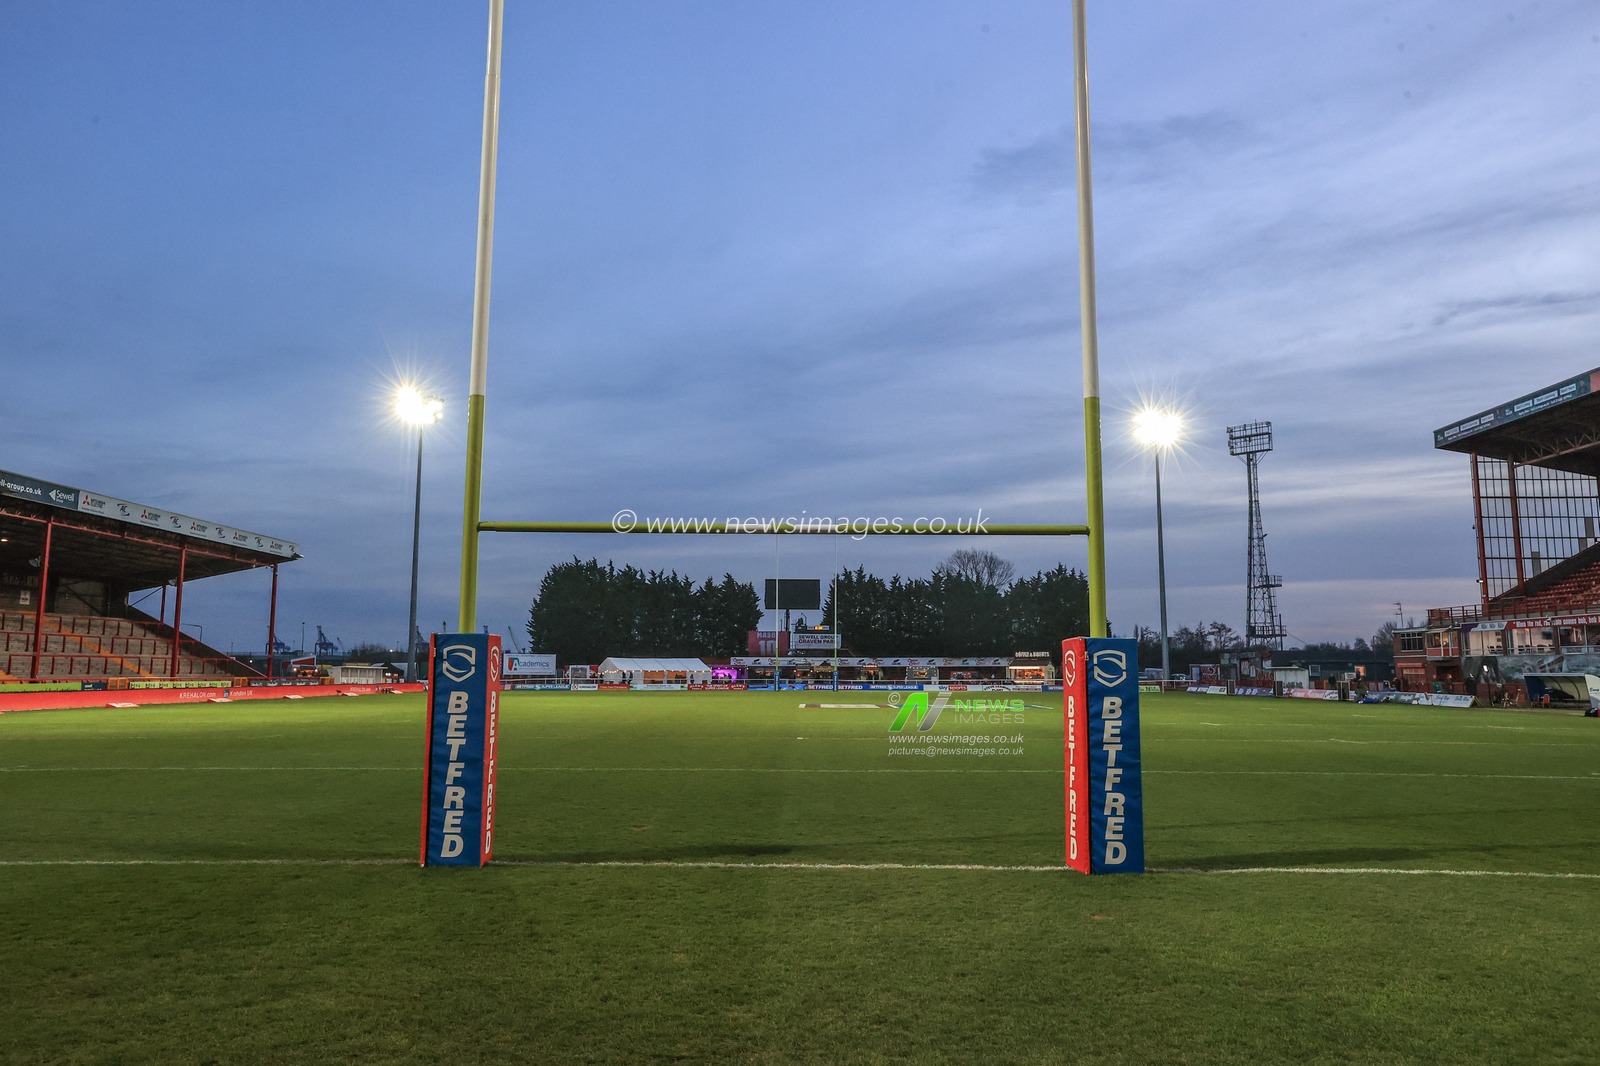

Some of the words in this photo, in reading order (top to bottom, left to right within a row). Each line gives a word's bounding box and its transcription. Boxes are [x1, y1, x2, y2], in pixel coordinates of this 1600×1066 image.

[56, 490, 75, 502] Sewell
[440, 691, 469, 858] BETFRED
[485, 691, 497, 855] BETFRED
[1068, 695, 1078, 861] BETFRED
[1101, 696, 1127, 865] BETFRED
